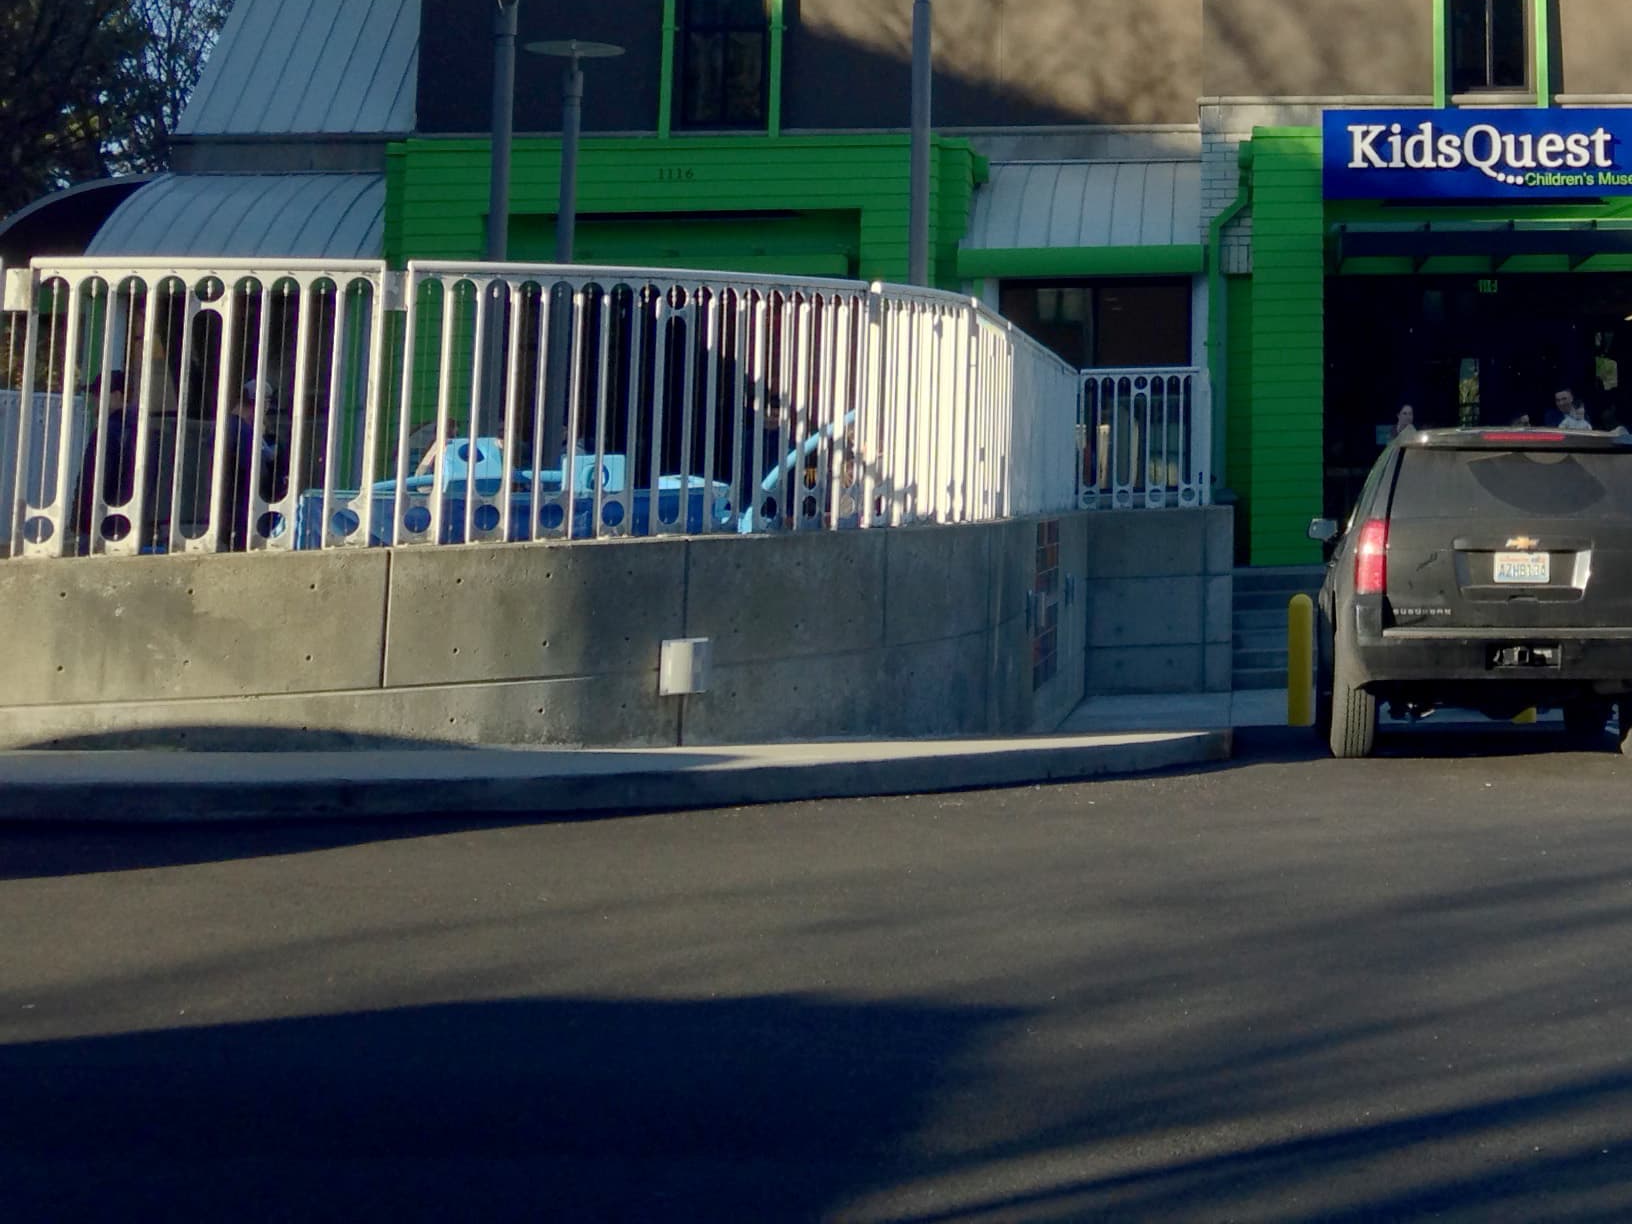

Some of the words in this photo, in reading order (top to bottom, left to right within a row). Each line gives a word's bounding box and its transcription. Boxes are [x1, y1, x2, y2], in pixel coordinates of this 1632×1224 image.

[1347, 122, 1612, 178] KidsQuest
[658, 167, 694, 180] 1116
[1525, 172, 1595, 186] Children's
